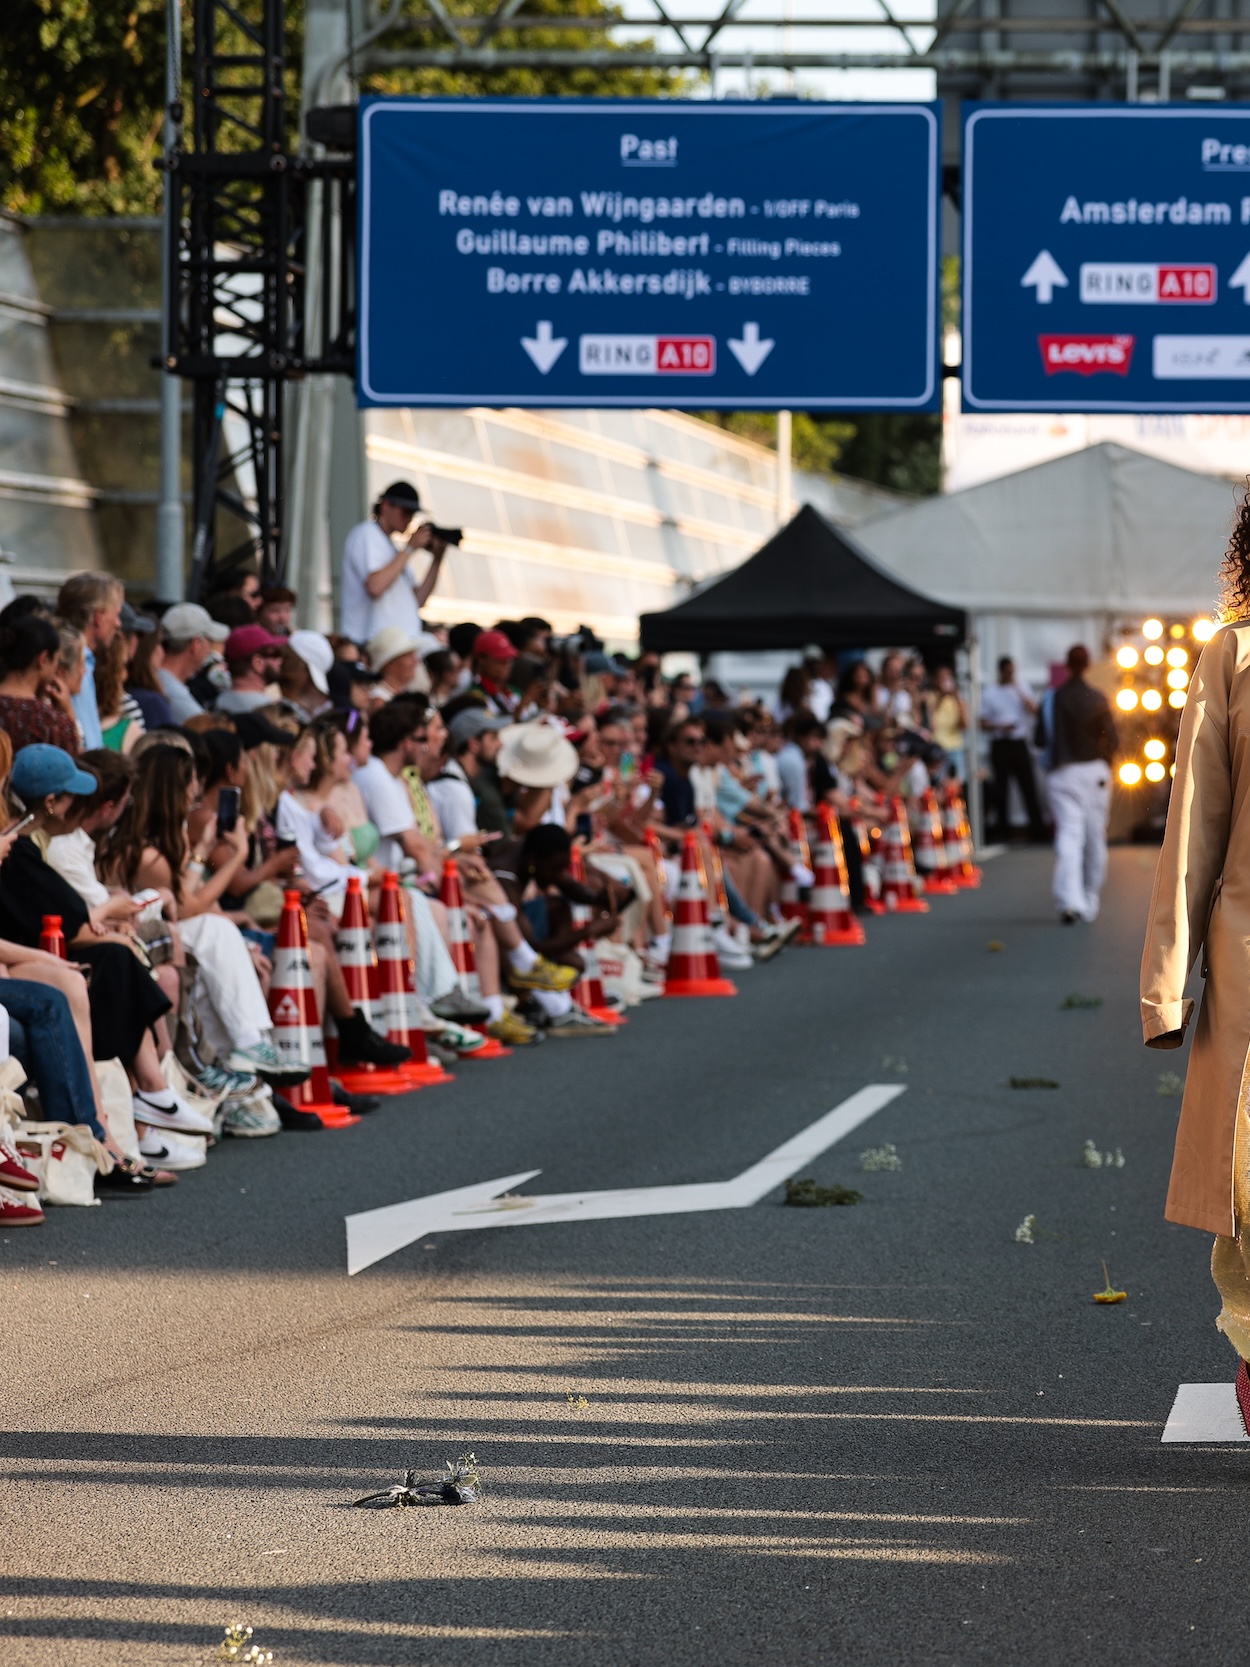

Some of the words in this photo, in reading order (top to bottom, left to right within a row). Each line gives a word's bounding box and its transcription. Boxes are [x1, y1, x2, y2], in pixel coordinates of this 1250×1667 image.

[620, 134, 678, 160] Past
[439, 189, 521, 217] Renée
[527, 196, 573, 217] van
[580, 192, 745, 223] Wijngaarden
[1060, 196, 1231, 225] Amsterdam
[456, 228, 590, 256] Guillaume
[597, 229, 710, 256] Philibert
[726, 237, 782, 260] Filling
[487, 267, 562, 294] Borre
[568, 268, 711, 300] Akkersdijk
[1086, 272, 1153, 294] RING
[1160, 274, 1211, 295] A10
[585, 344, 652, 365] RING
[661, 346, 708, 365] A10
